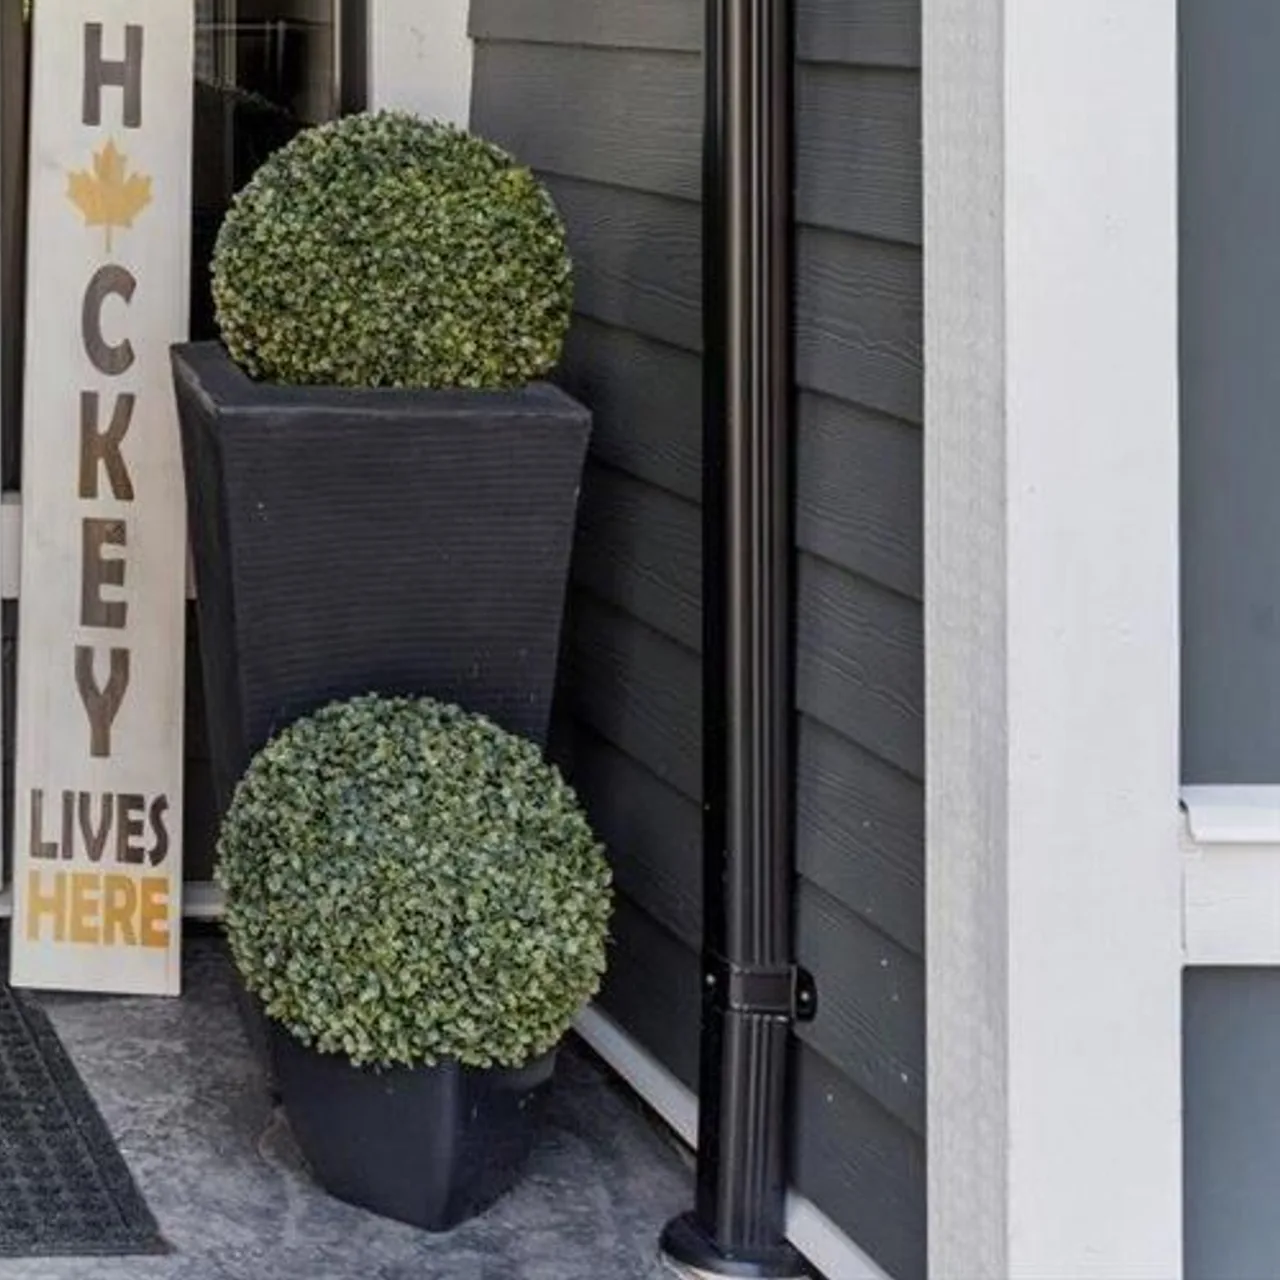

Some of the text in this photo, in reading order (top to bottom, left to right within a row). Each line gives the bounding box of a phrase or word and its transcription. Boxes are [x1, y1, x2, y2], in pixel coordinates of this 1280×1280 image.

[70, 22, 147, 757] HCKEY
[29, 789, 169, 867] LIVES
[27, 870, 170, 948] HERE
